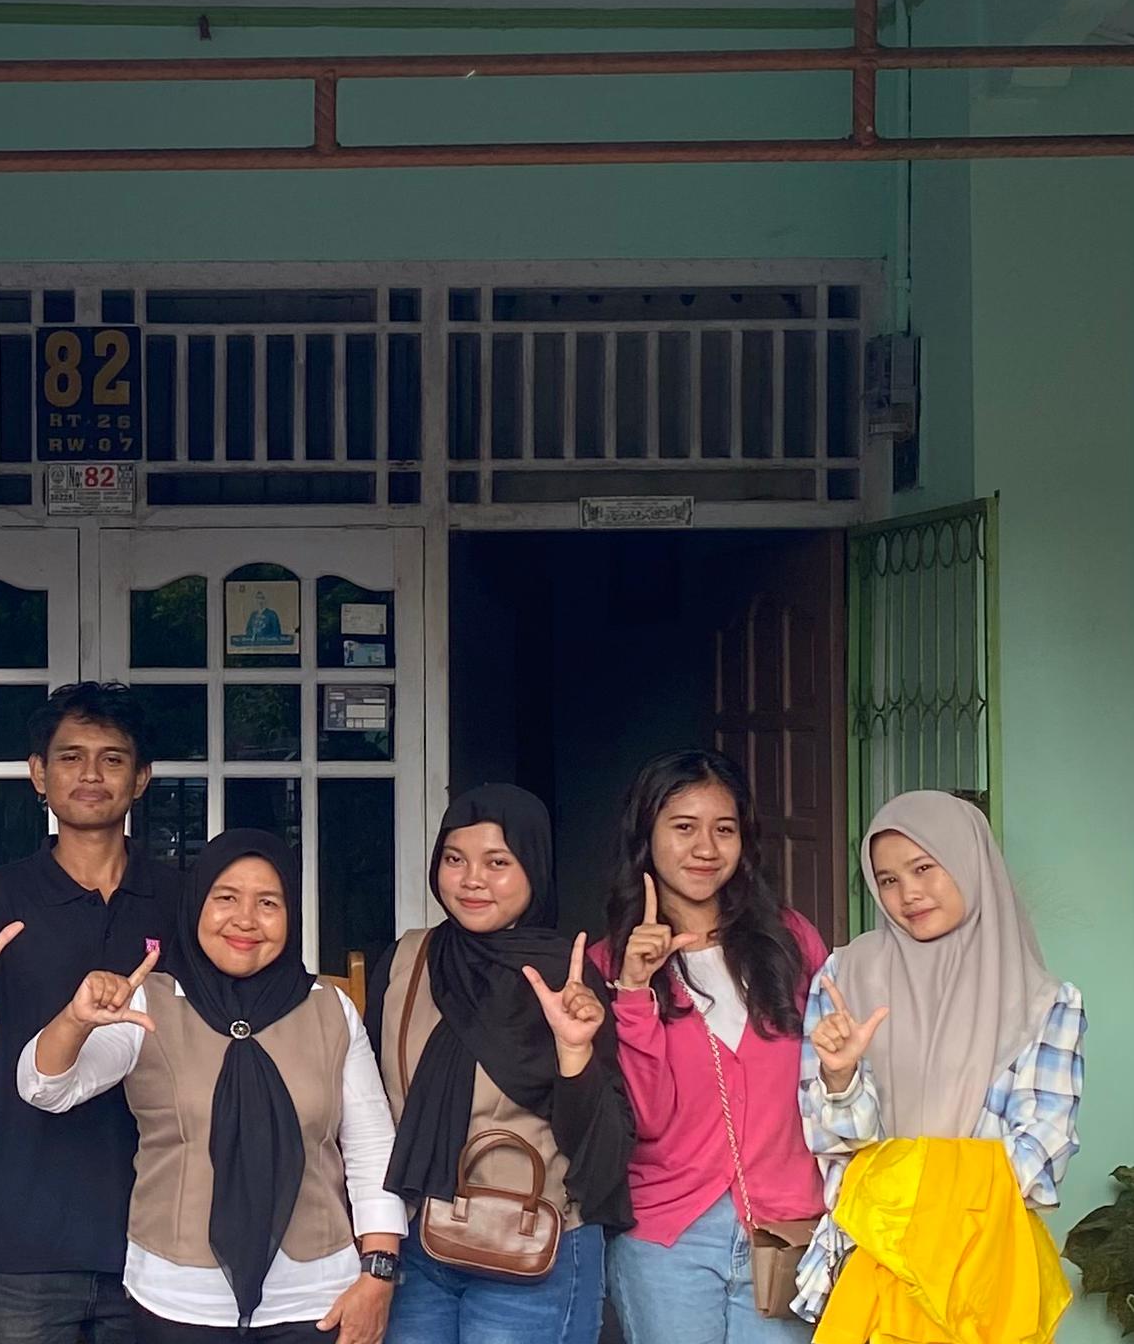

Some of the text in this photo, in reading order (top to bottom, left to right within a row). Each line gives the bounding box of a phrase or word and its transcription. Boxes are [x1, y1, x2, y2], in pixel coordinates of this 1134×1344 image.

[44, 329, 131, 408] 82
[49, 413, 82, 428] RT
[48, 438, 85, 453] RW
[85, 467, 115, 487] 82
